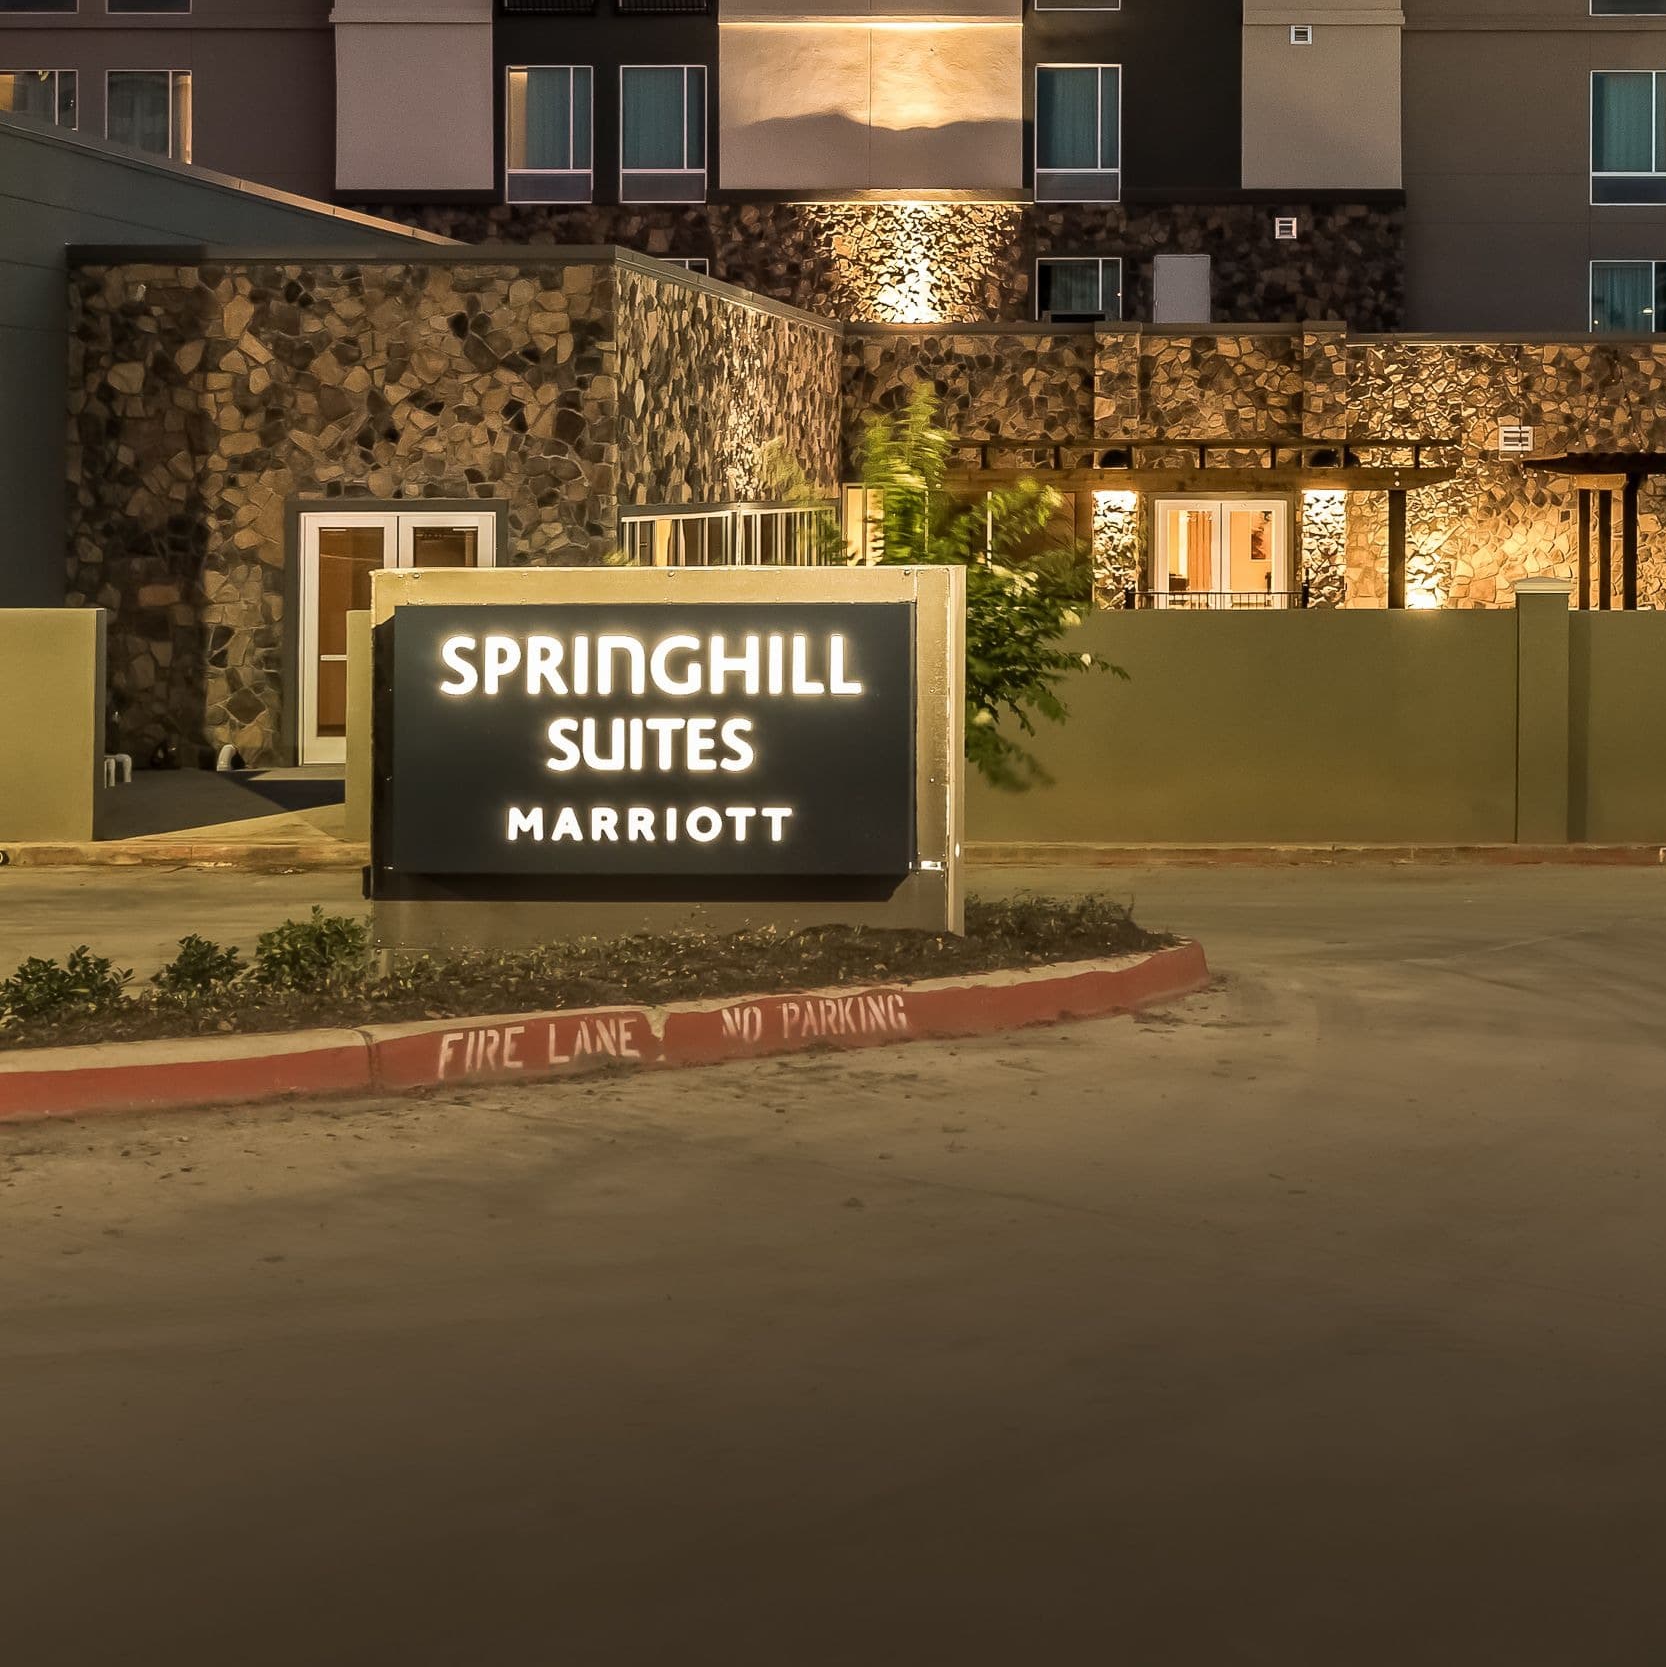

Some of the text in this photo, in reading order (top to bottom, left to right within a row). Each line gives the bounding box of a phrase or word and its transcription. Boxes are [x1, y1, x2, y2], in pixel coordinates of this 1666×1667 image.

[439, 633, 864, 696] SPRINGHILL
[546, 717, 754, 772] SUITES
[508, 806, 793, 842] MARRIOTT
[436, 994, 909, 1080] FIRE LANE NO PARKING
